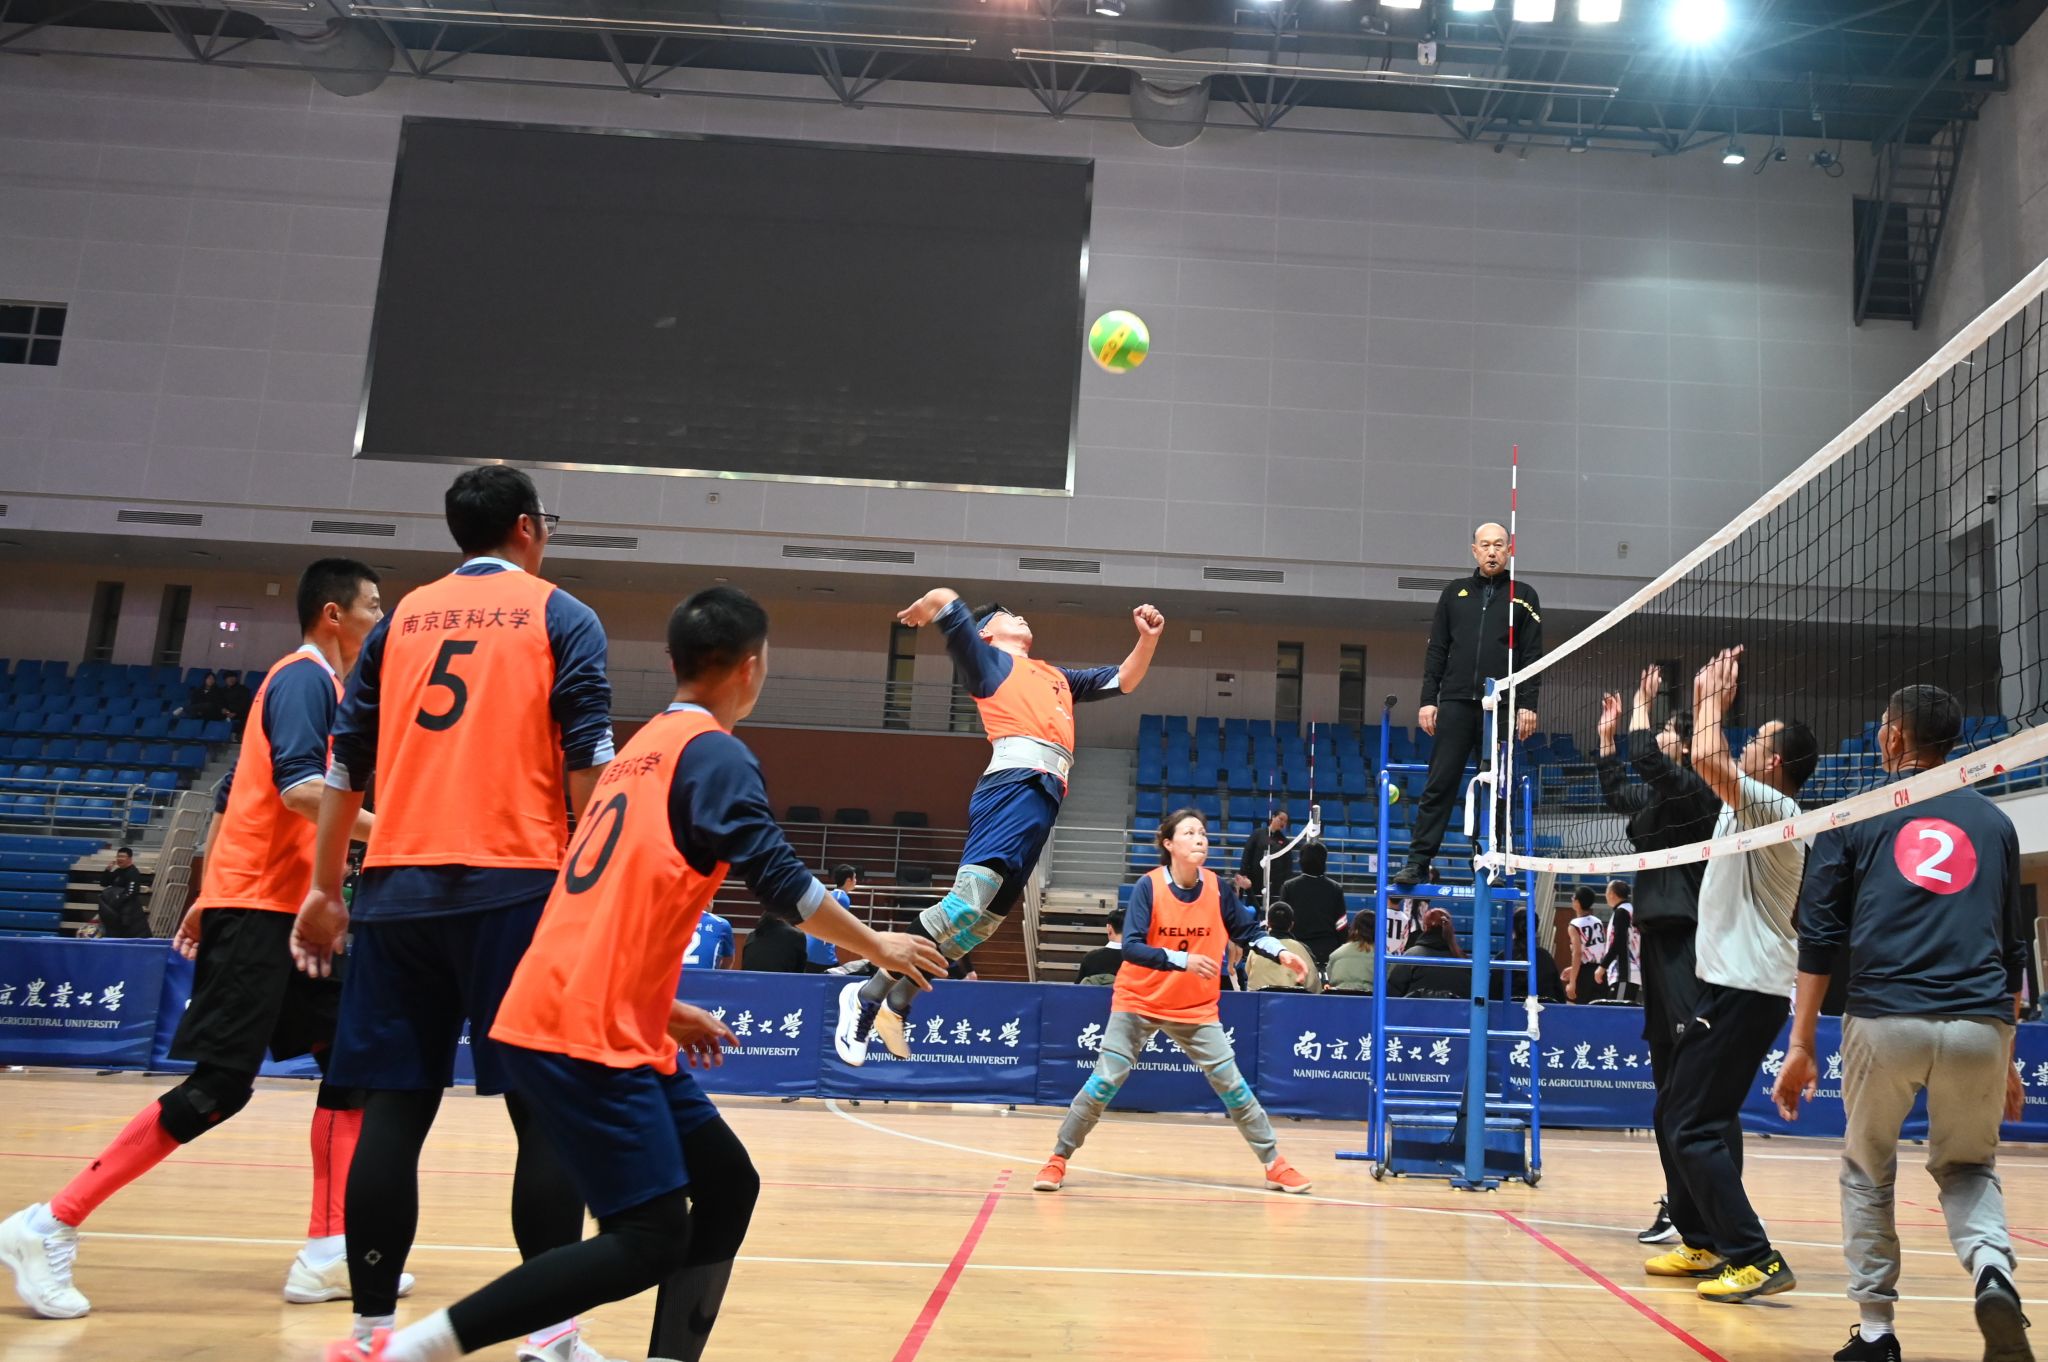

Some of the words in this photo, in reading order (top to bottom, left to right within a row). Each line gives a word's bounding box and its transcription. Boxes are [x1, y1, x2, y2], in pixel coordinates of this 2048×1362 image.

[402, 608, 530, 636] 南京医科大学
[415, 639, 478, 732] 5
[1894, 788, 1910, 808] CVA
[1915, 829, 1954, 884] 2
[1158, 927, 1204, 937] KELME
[1582, 922, 1605, 947] 23
[65, 1019, 120, 1029] UNIVERSITY
[746, 1047, 800, 1057] UNIVERSITY
[1293, 1030, 1452, 1066] 南京農業大學
[1509, 1040, 1652, 1071] 南京農業大
[864, 1052, 897, 1063] ANJING
[966, 1055, 1019, 1065] UNIVERSITY
[1130, 1061, 1181, 1072] RICULTURAL
[1293, 1068, 1330, 1079] NANJING
[1332, 1070, 1397, 1081] AGRICULAL
[1399, 1073, 1450, 1083] UNIVERSITY
[1549, 1078, 1613, 1089] AGRICULTURAL
